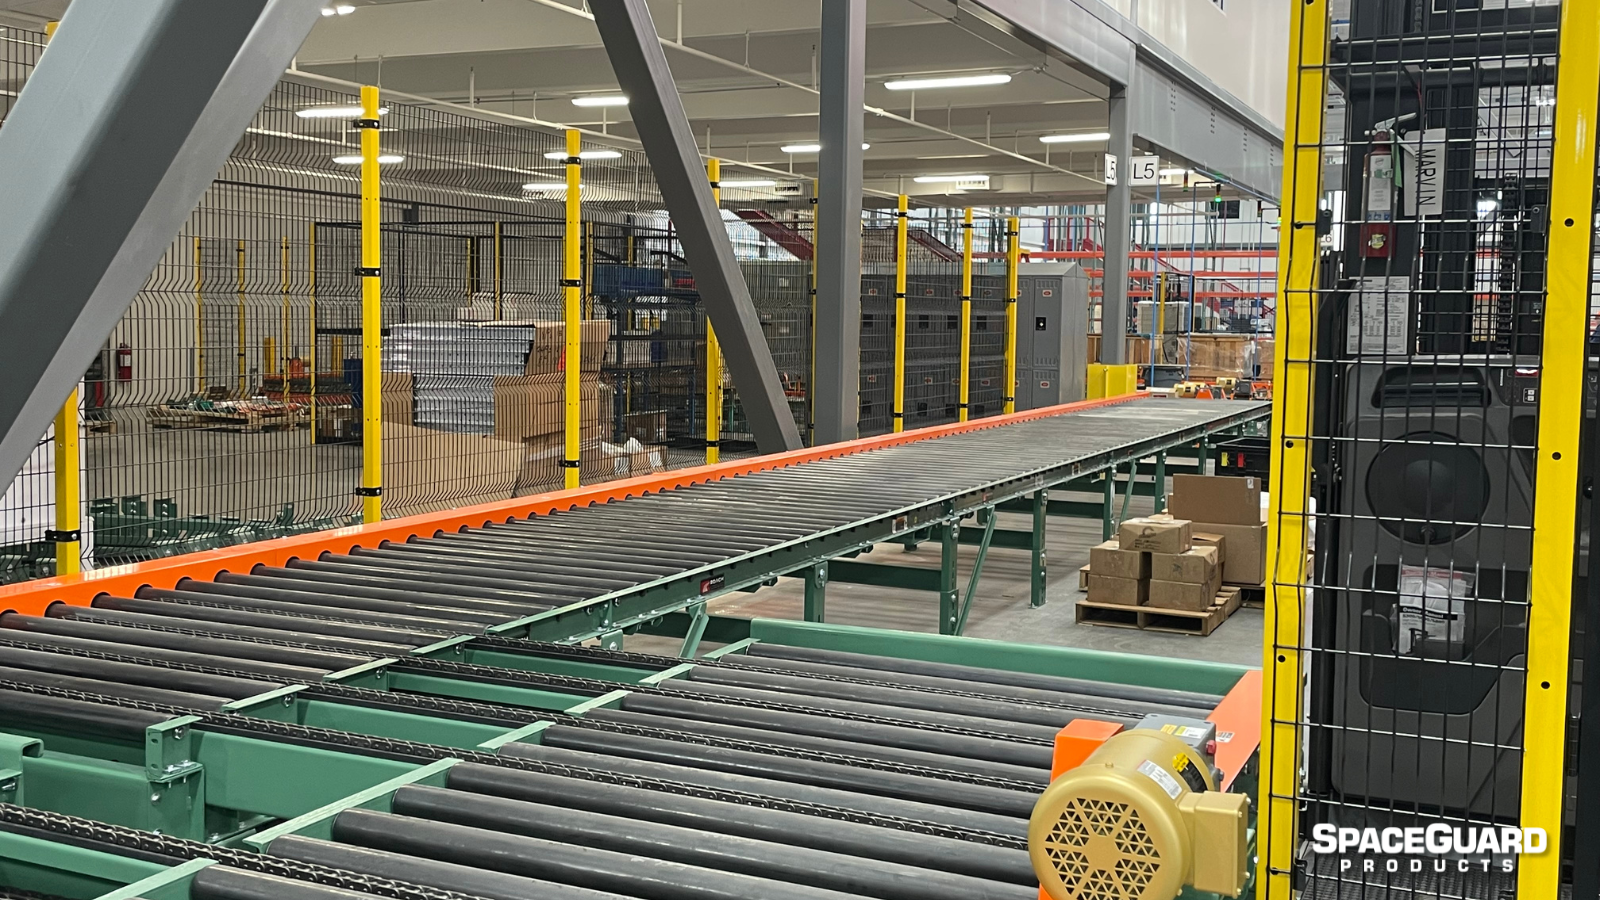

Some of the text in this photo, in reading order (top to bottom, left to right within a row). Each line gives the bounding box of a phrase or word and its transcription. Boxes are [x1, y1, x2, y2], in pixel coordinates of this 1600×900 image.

[1105, 160, 1116, 181] L5
[1133, 162, 1155, 179] L5
[1415, 149, 1436, 205] MARVIN
